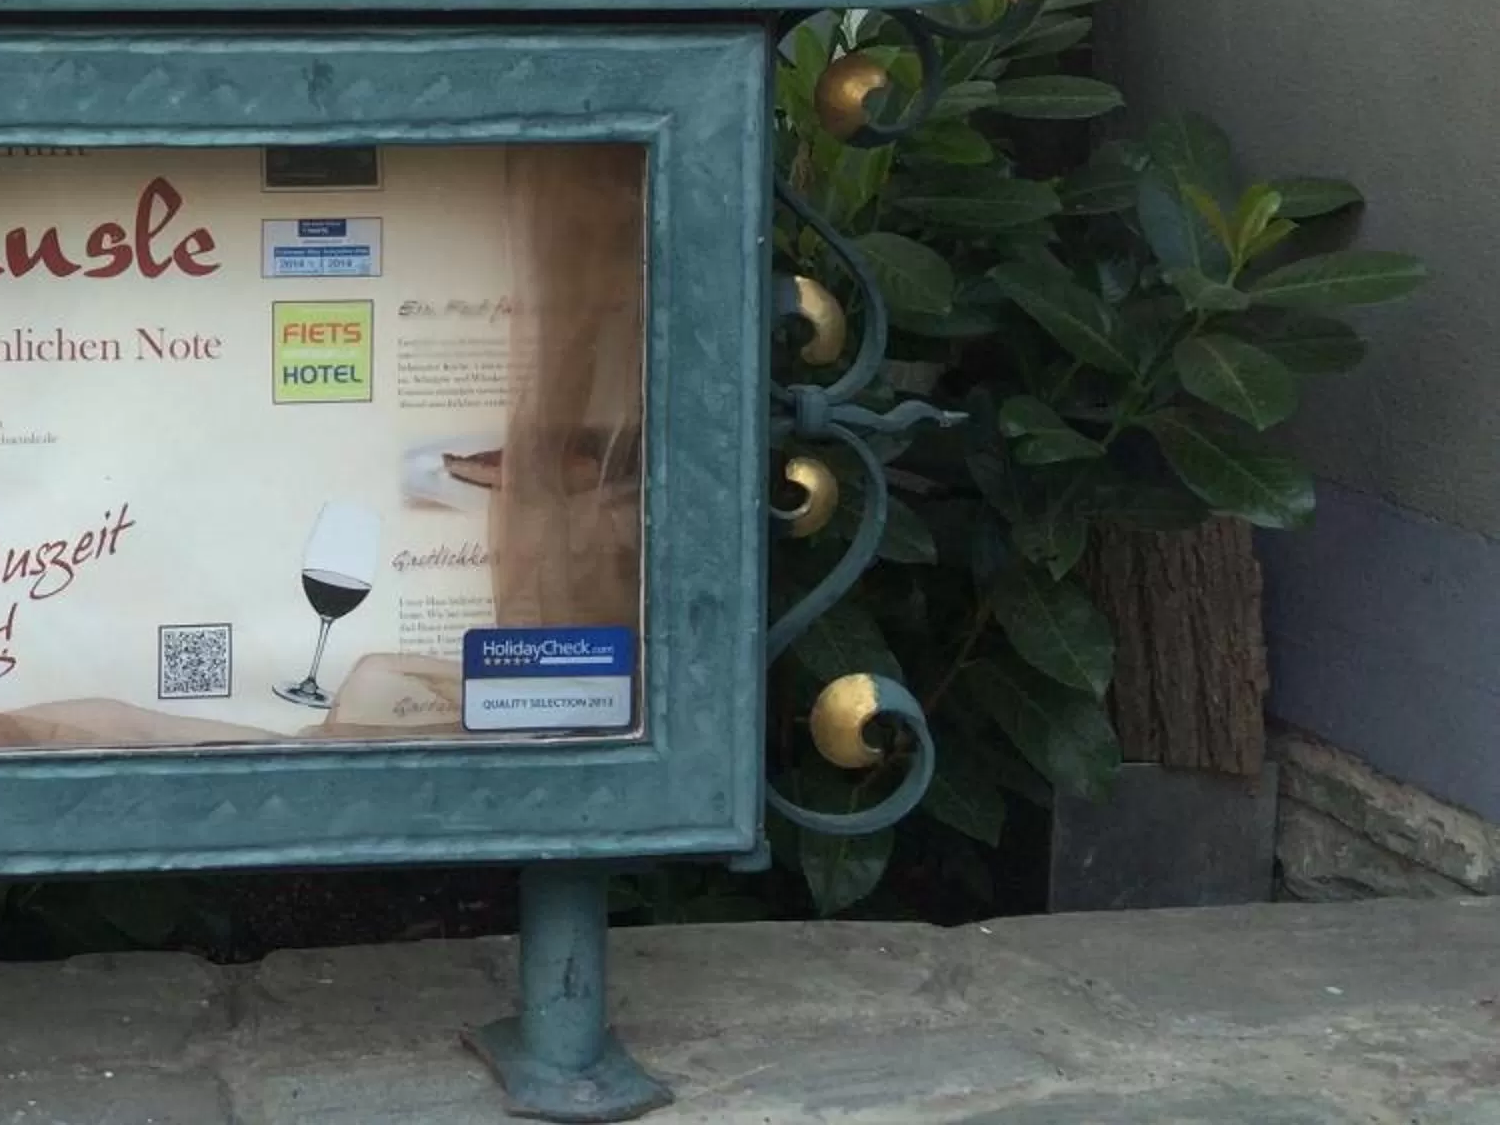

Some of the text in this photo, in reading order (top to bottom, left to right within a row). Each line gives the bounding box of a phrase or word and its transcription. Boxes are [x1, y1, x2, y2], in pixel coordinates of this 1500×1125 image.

[282, 322, 362, 344] FIETS
[136, 327, 222, 361] Note
[282, 364, 363, 385] HOTEL
[482, 698, 527, 710] QUALITY
[529, 697, 587, 709] SELECTION
